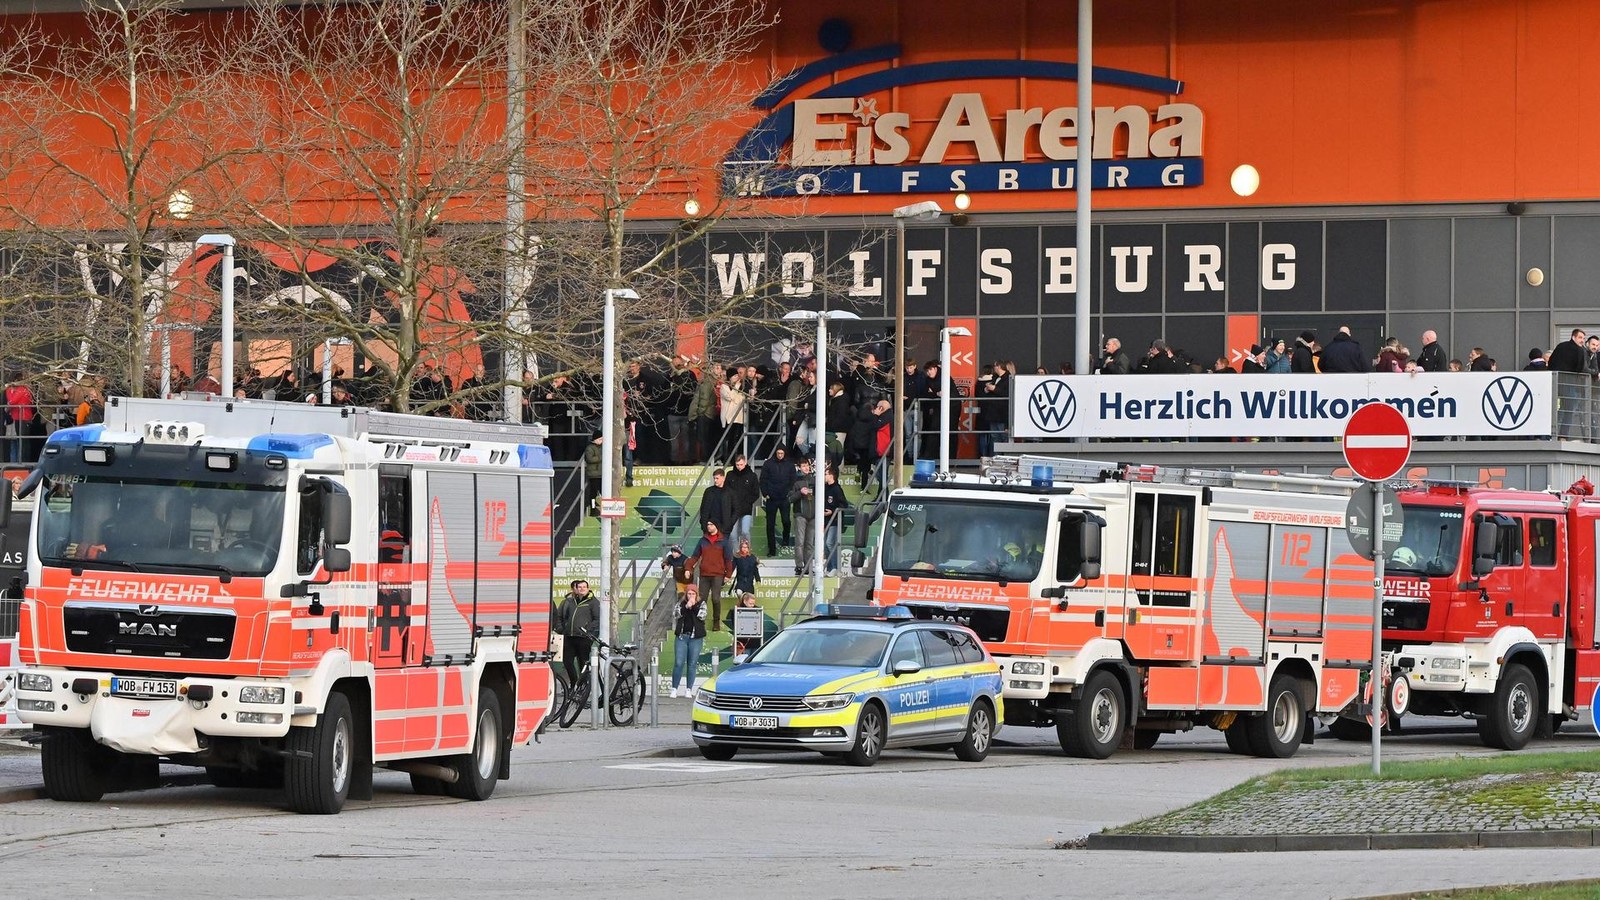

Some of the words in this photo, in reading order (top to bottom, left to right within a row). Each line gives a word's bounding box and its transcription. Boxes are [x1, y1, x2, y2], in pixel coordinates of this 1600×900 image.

[791, 97, 910, 167] Eis
[918, 93, 1203, 164] Arena
[734, 164, 1185, 196] WOLFSBURG
[712, 243, 1297, 298] WOLFSBURG
[1100, 390, 1231, 420] Herzlich
[1240, 390, 1457, 419] Willkomen
[484, 500, 507, 541] 112
[1281, 532, 1312, 567] 112
[66, 578, 210, 603] FEUERWEHR
[899, 583, 993, 601] FEUERWEHR
[119, 622, 177, 637] MAN
[932, 614, 971, 625] MAN
[118, 680, 136, 692] WOB
[142, 681, 155, 692] FW
[157, 682, 174, 694] 153
[900, 690, 930, 708] POLIZEI
[734, 717, 748, 726] WOB
[752, 718, 758, 726] P
[758, 718, 776, 727] 3031
